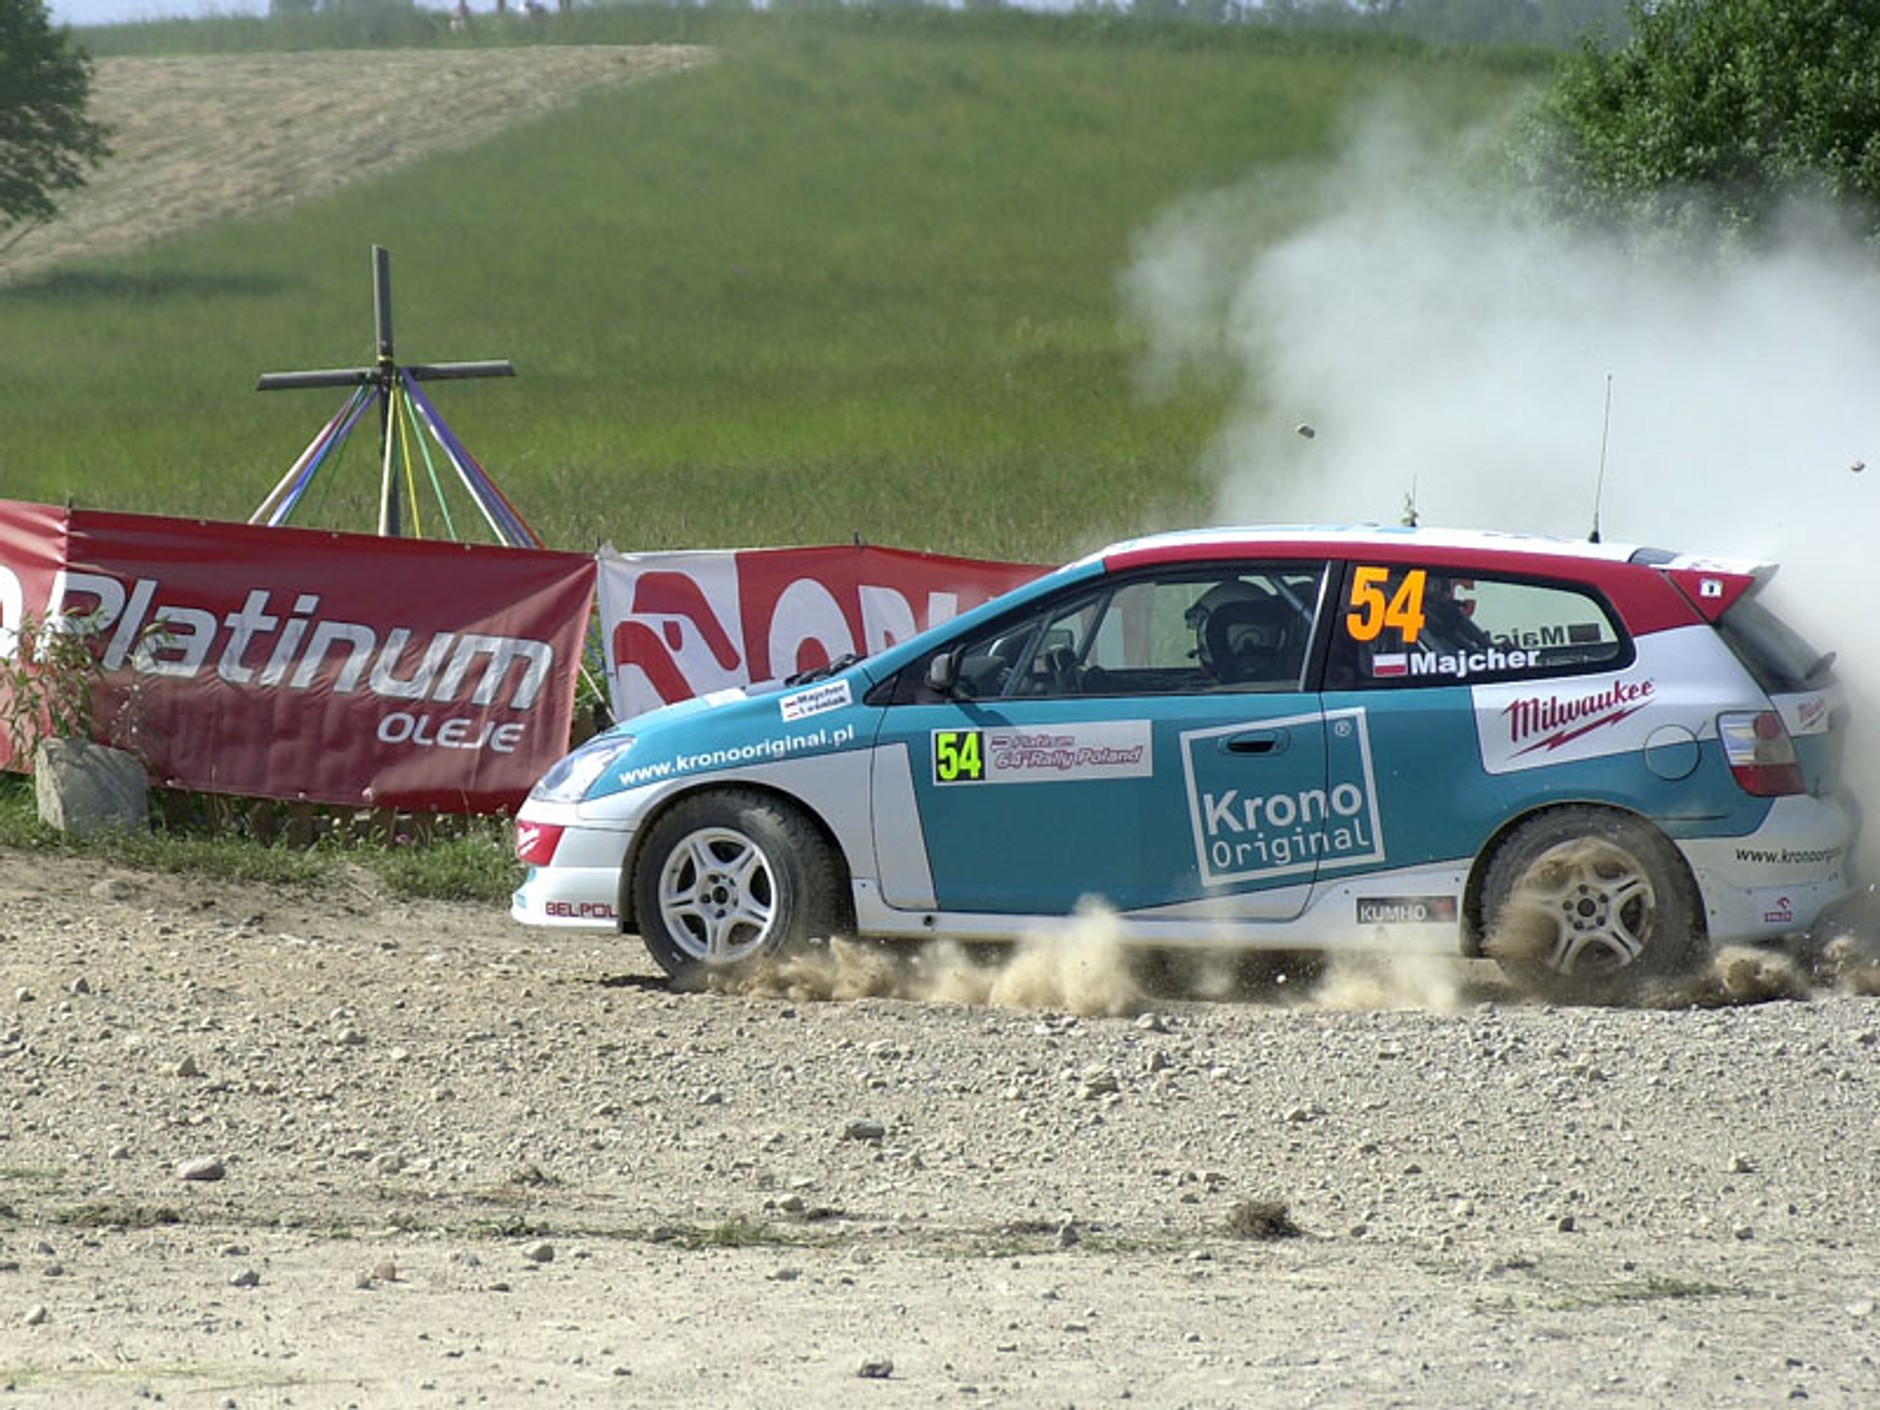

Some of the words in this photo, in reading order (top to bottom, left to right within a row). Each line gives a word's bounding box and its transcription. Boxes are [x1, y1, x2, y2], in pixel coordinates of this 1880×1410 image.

[1345, 565, 1428, 643] 54
[33, 571, 554, 710] Platinum
[1409, 646, 1541, 678] Majcher
[376, 711, 526, 754] OLEJE
[1501, 679, 1655, 743] Milwaukee
[618, 724, 855, 786] www.kronooriginal.pl
[936, 731, 982, 781] 54
[1076, 747, 1141, 764] Poland
[1203, 782, 1363, 836] Krono
[1211, 817, 1371, 869] Original
[545, 901, 619, 919] BELPOL
[1360, 904, 1428, 922] KUMHO
